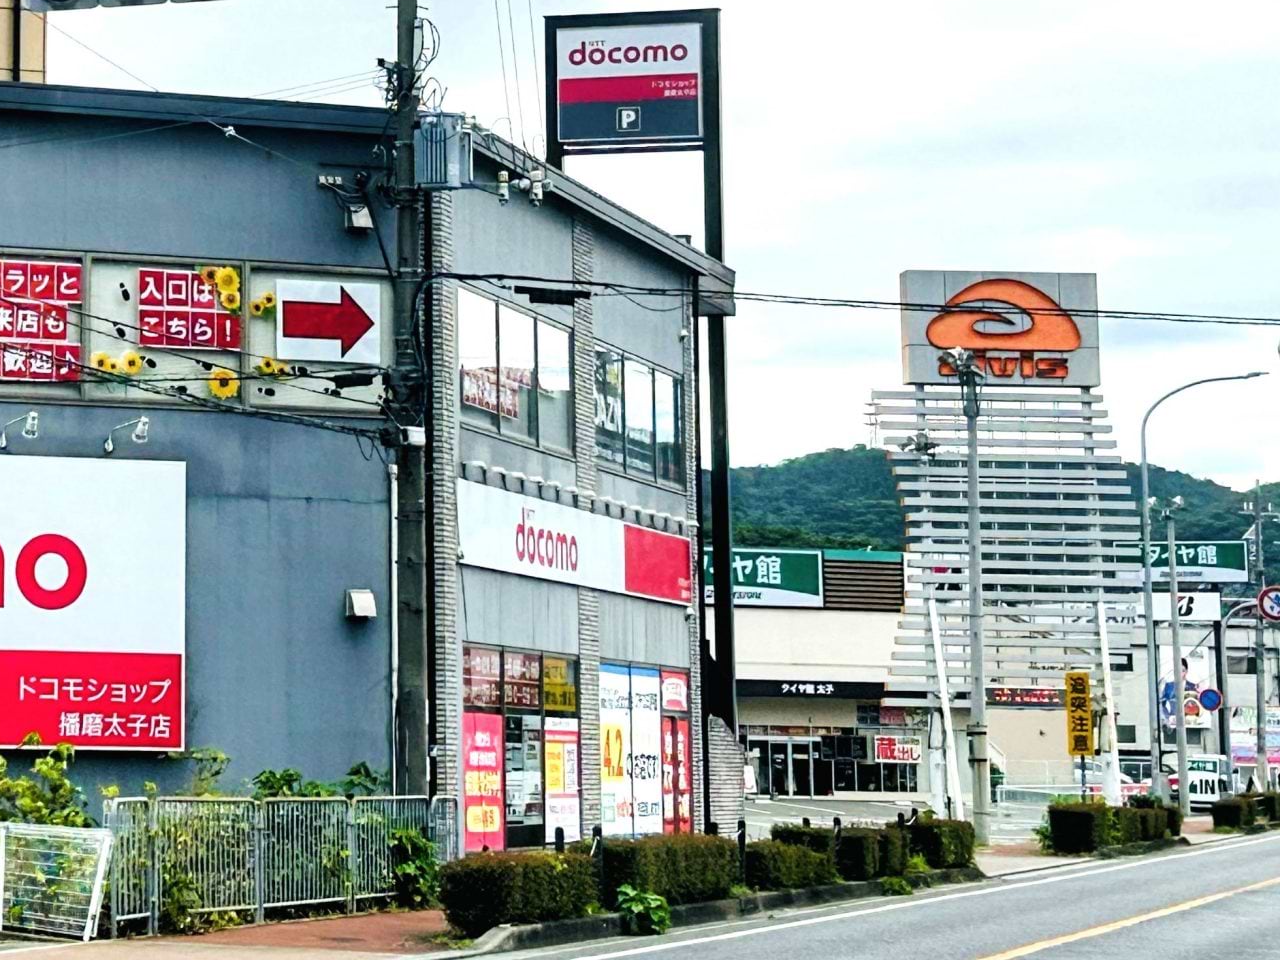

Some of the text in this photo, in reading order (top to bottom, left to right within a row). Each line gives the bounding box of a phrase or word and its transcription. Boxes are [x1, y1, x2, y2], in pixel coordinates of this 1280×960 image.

[568, 41, 688, 66] docomo
[140, 276, 214, 302] 入口は
[515, 507, 578, 572] docomo
[19, 676, 172, 704] ドコモショップ
[59, 712, 171, 739] 播磨太子店
[876, 737, 921, 761] 蔵出し
[1199, 778, 1216, 795] IN
